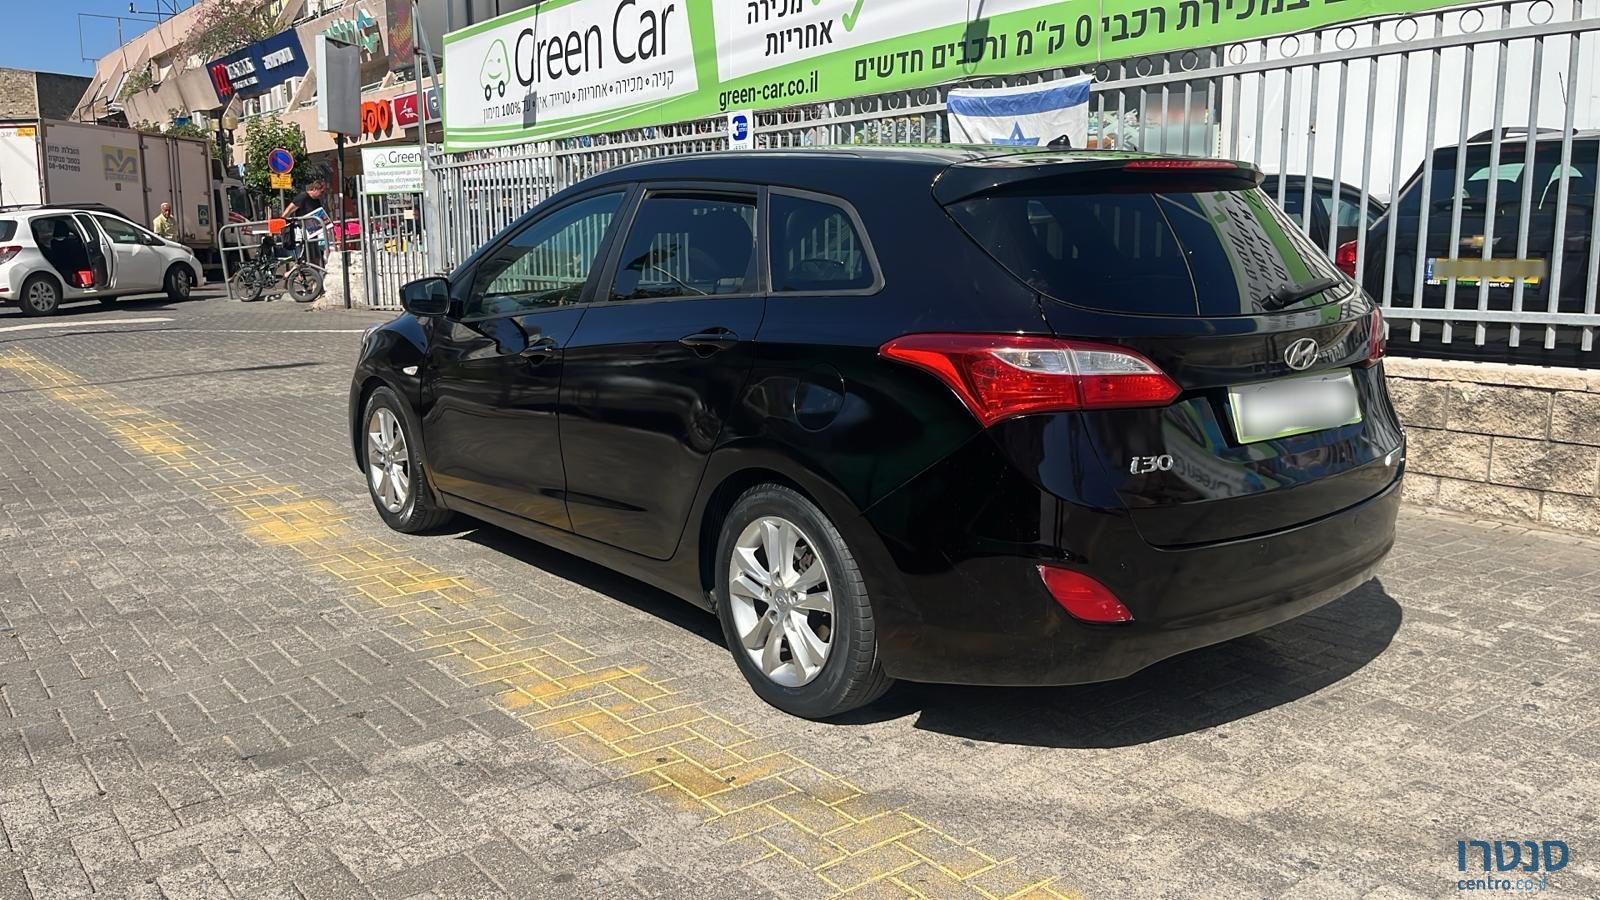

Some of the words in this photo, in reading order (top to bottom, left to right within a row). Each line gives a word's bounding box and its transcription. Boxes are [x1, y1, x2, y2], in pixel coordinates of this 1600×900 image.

[1075, 14, 1093, 47] 0
[1101, 5, 1166, 41] רכבי
[515, 25, 602, 87] Green
[613, 0, 674, 64] Car
[765, 20, 833, 56] אחריות
[932, 33, 1006, 69] ורכבים
[855, 49, 924, 82] חדשים
[578, 83, 607, 102] אחריות
[616, 76, 643, 94] מכירה
[652, 70, 674, 90] קניה
[719, 70, 818, 111] green-car.co.il
[502, 101, 520, 117] 100%
[549, 91, 570, 107] טרייד
[388, 151, 422, 164] Green
[1130, 454, 1174, 475] i30
